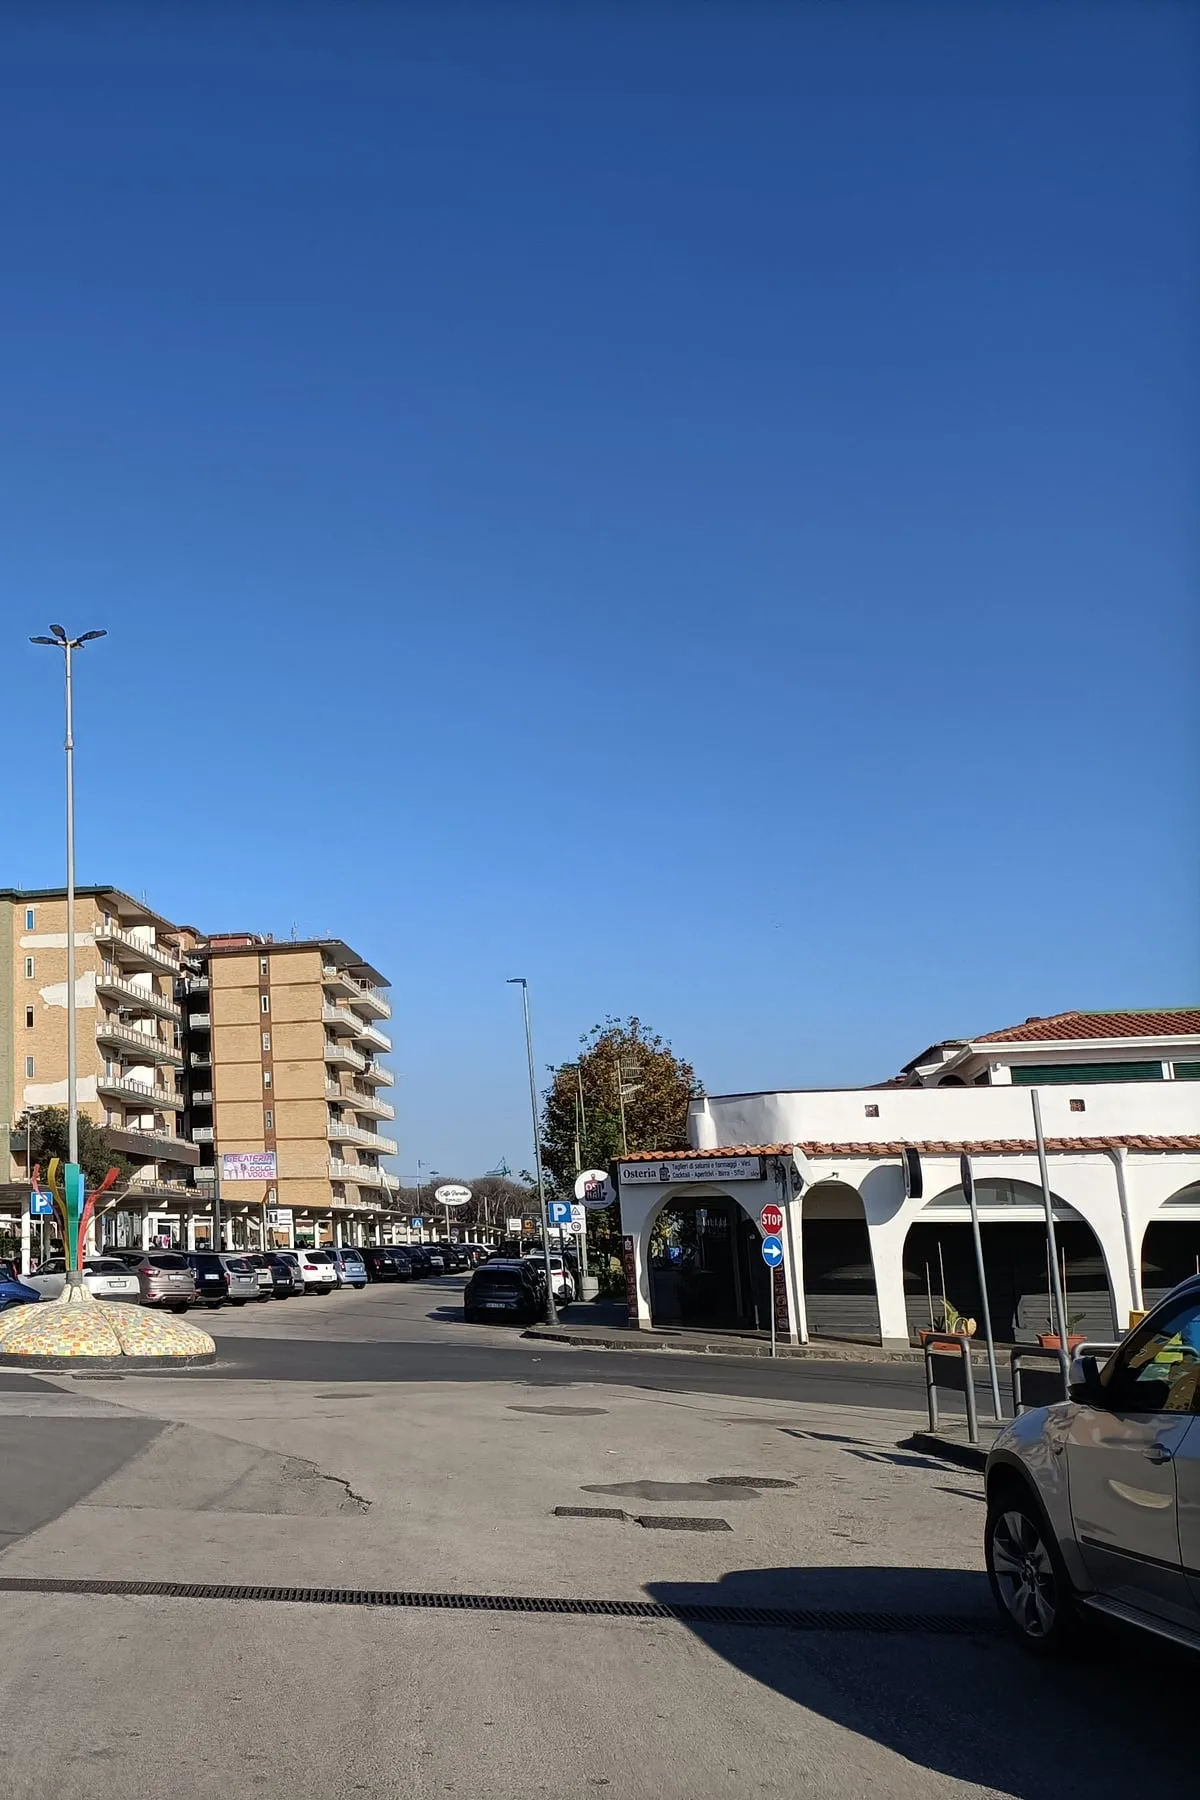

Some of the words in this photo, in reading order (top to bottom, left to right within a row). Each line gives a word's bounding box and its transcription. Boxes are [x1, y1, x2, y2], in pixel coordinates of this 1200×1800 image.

[227, 1154, 273, 1162] GELATERIA
[623, 1168, 657, 1179] Osteria
[553, 1203, 567, 1221] P
[762, 1213, 781, 1226] STOP
